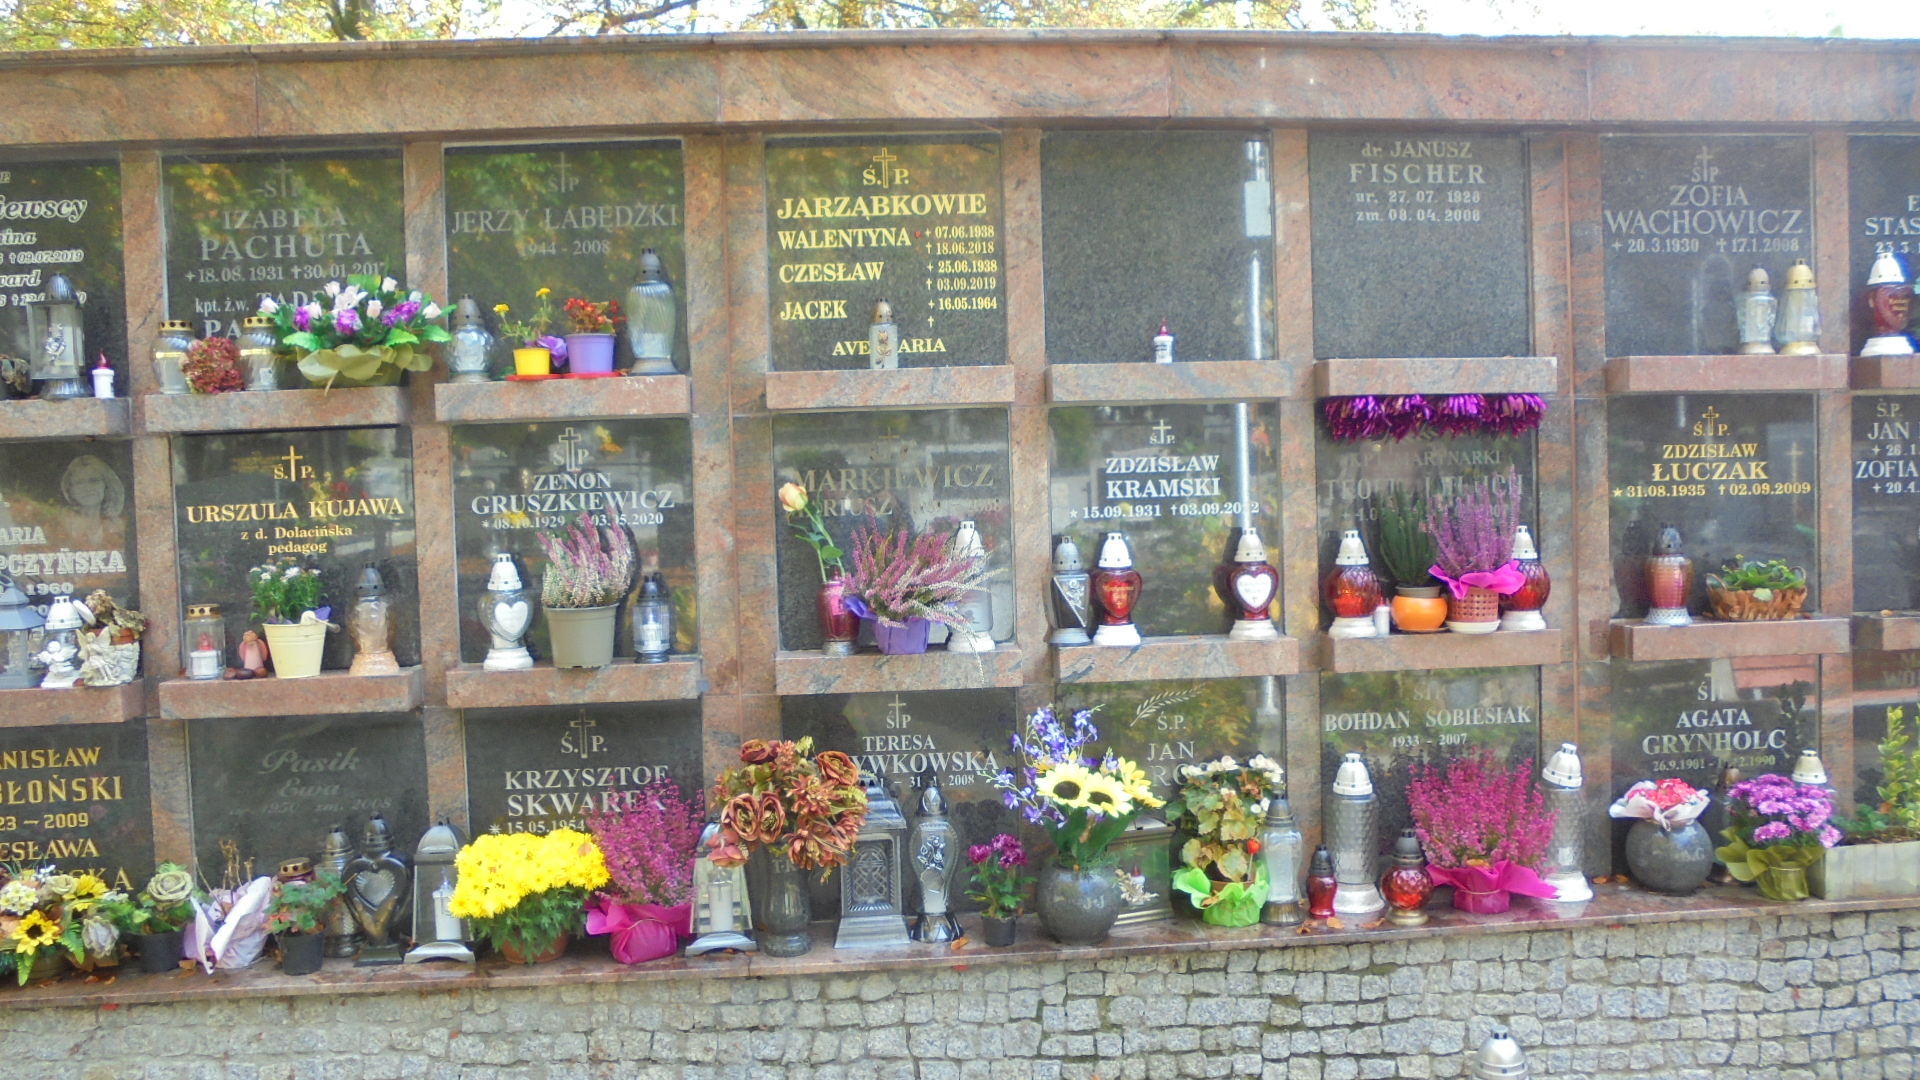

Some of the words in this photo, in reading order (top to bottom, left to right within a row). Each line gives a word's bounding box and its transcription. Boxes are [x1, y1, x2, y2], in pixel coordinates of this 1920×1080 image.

[1361, 142, 1383, 158] dr.
[1390, 141, 1473, 158] JANUSZ
[1349, 162, 1486, 184] FISCHER
[1356, 192, 1379, 203] ur.
[1669, 184, 1750, 206] ZOFIA
[777, 193, 987, 221] JARZĄBKOWIE
[1356, 210, 1384, 222] zm.
[222, 206, 347, 229] IZABELA
[452, 208, 529, 233] JERZY
[1605, 208, 1804, 235] WACHOWICZ
[200, 232, 372, 260] PACHUTA
[573, 240, 611, 255] 2008
[778, 227, 912, 250] WALENTYNA
[934, 225, 995, 239] 07.06.1938
[1627, 238, 1699, 253] 20.3.1930
[1731, 237, 1799, 252] 17.1.2008
[17, 249, 84, 264] 09.07.2019
[935, 242, 995, 255] 18.06.2018
[779, 262, 884, 283] CZESŁAW
[938, 260, 998, 274] 25.06.1938
[937, 277, 997, 291] 03.09.2019
[195, 298, 221, 317] kpt.
[780, 300, 848, 320] JACEK
[938, 297, 998, 310] 16.05.1964
[832, 340, 871, 356] AVE
[897, 338, 946, 354] ARIA
[1867, 421, 1910, 439] JAN
[1663, 443, 1758, 459] ZDZISŁAW
[1106, 455, 1220, 474] ZDZISŁAW
[1652, 461, 1768, 481] ŁUCZAK
[1855, 460, 1919, 479] ZOFIA
[533, 472, 612, 492] ZENON
[792, 464, 994, 493] MARKIEWICZ
[1106, 477, 1221, 499] KRAMSKI
[1626, 484, 1706, 498] 31.08.1935
[1729, 482, 1811, 496] 02.09.2009
[187, 501, 299, 523] URSZULA
[308, 497, 405, 518] KUJAWA
[471, 490, 675, 514] GRUSZKIEWICZ
[1082, 504, 1162, 519] 15.09.1931
[1179, 502, 1260, 515] 03.09.202
[493, 515, 566, 530] 08.10.1929
[592, 512, 664, 526] 03.5.2020
[241, 531, 249, 540] z
[255, 528, 268, 540] d.
[274, 525, 353, 540] Dolacińska
[268, 541, 328, 556] pedagog
[26, 582, 74, 595] 1960
[1325, 710, 1411, 732] BOHDAN
[1425, 705, 1532, 728] SOBIESIAK
[1676, 708, 1752, 729] AGATA
[862, 734, 936, 752] TERESA
[1147, 740, 1195, 761] JAN
[1392, 735, 1420, 748] 1933
[1438, 733, 1468, 746] 2007
[1642, 729, 1787, 756] GRYNHOLC
[0, 747, 101, 769] NISŁAW
[257, 747, 361, 774] Pasik
[849, 751, 1000, 774] YWKOWSKA
[277, 777, 342, 797] Ewa
[505, 765, 669, 790] KRZYSZTOF
[0, 774, 123, 804] ŁOŃSKI
[44, 812, 89, 829] 2009
